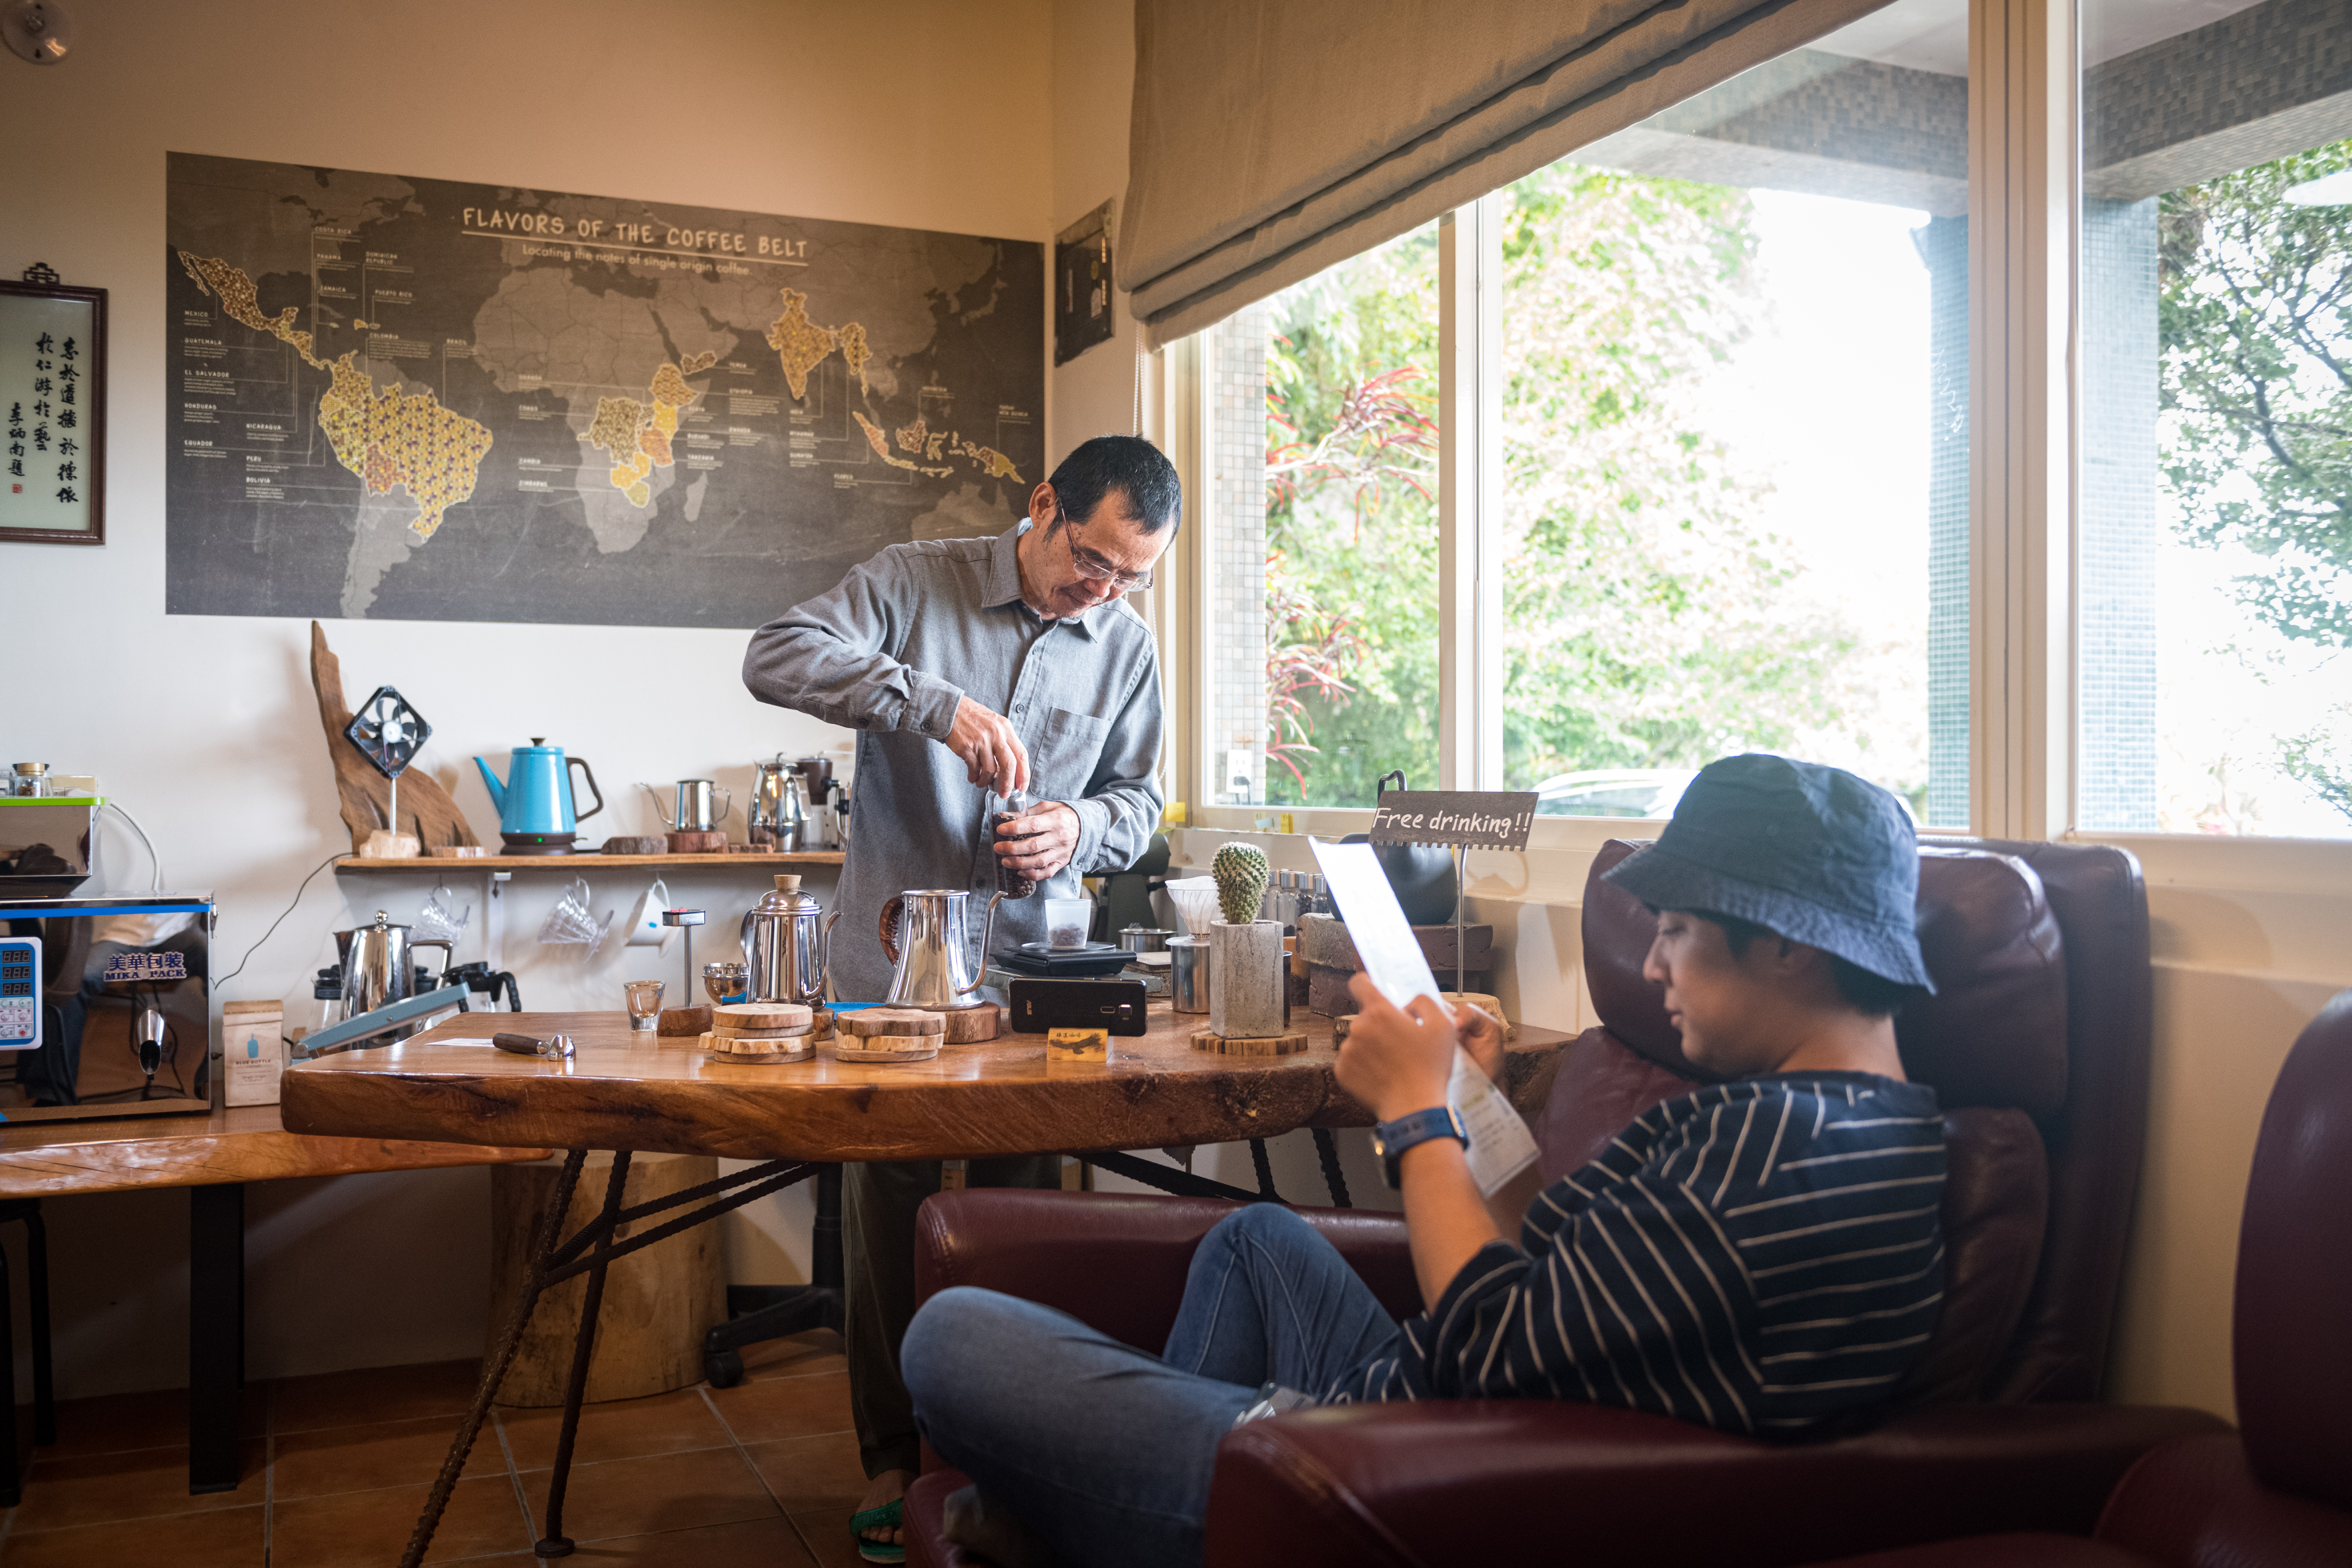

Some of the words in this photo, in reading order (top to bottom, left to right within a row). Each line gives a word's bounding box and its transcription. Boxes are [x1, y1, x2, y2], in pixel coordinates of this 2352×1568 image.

[463, 207, 565, 234] FLAVORS
[578, 219, 603, 238] OF
[615, 223, 654, 243] THE
[667, 228, 747, 252] COFFEE
[758, 236, 807, 258] BELT
[523, 243, 571, 262] Locating
[575, 247, 593, 261] the
[596, 253, 626, 264] notes
[629, 253, 641, 265] of
[644, 256, 677, 270] single
[679, 259, 713, 274] origin
[1372, 807, 1424, 829] Free
[109, 953, 182, 971] 美華包裝
[105, 971, 140, 980] MIKA
[150, 969, 185, 978] PACK
